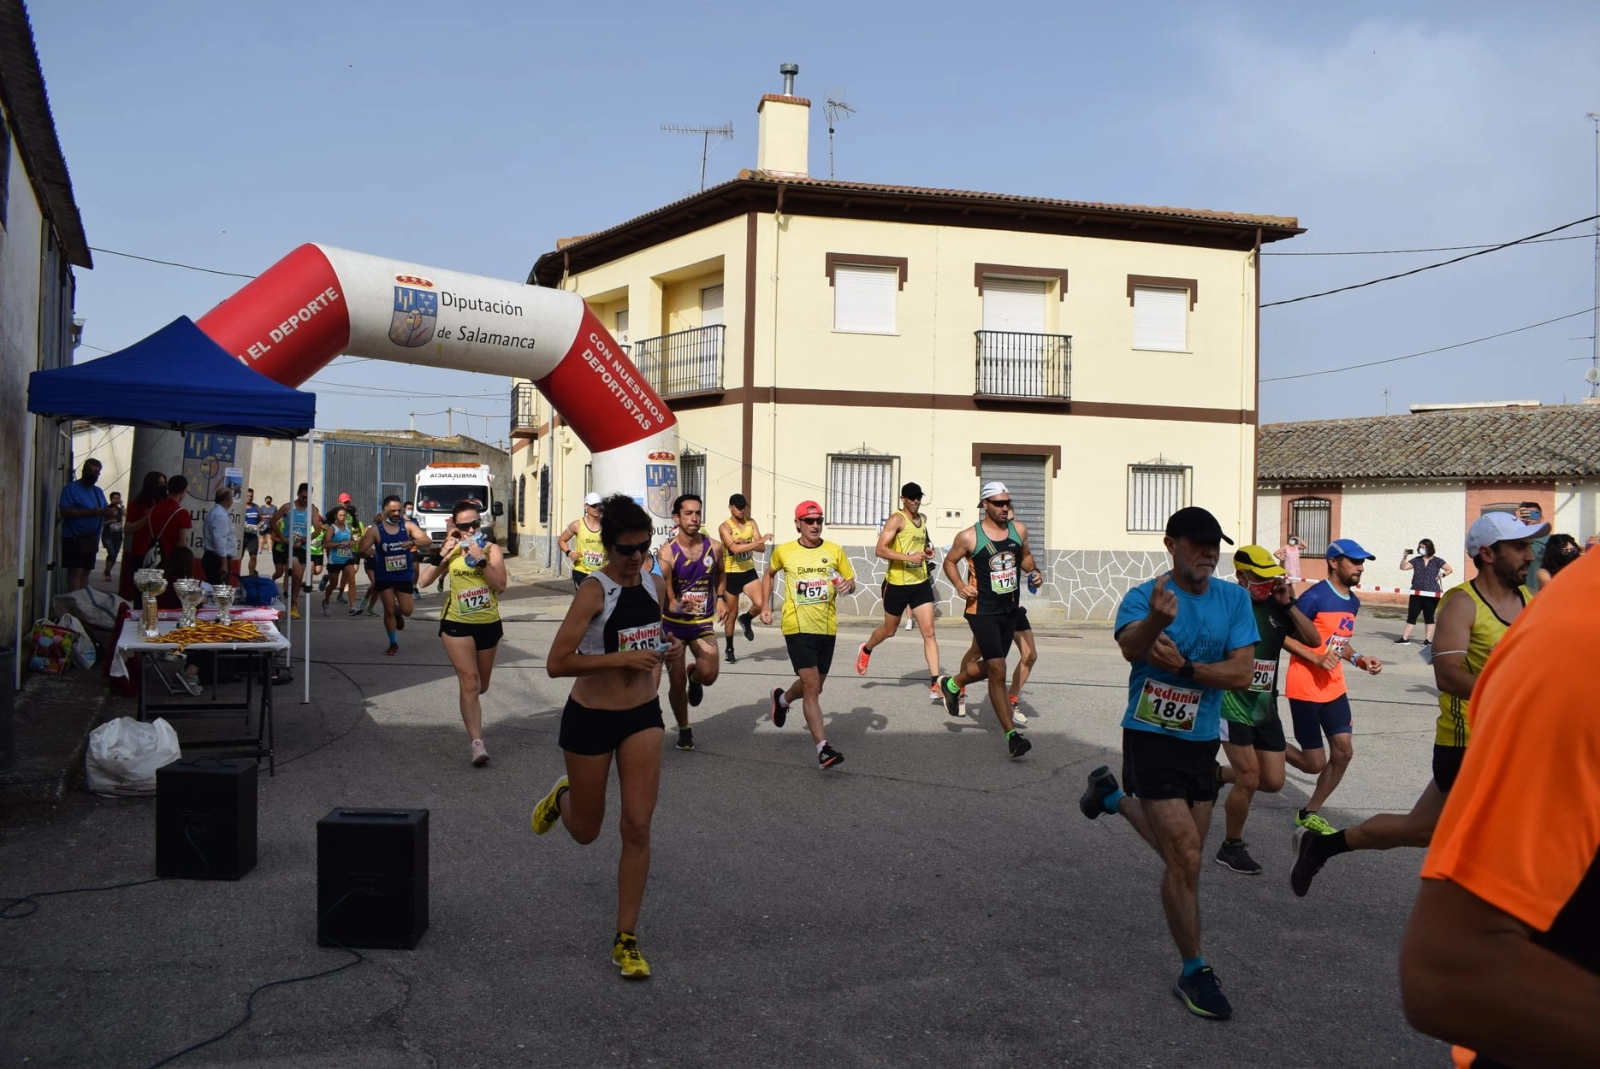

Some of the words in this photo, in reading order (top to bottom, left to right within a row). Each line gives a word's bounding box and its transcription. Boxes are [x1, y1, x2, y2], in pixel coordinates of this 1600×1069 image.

[441, 291, 523, 316] Diputación
[247, 341, 271, 360] EL
[269, 286, 339, 343] DEPORTE
[437, 326, 452, 339] de
[457, 325, 535, 349] Salamanca
[582, 349, 651, 430] DEPORTISTAS
[589, 332, 613, 360] CON
[612, 360, 665, 423] NUESTROS
[587, 556, 600, 564] 178
[463, 595, 485, 608] 172
[1254, 671, 1269, 684] 90
[1144, 681, 1200, 705] bedunia
[1152, 698, 1187, 720] 186
